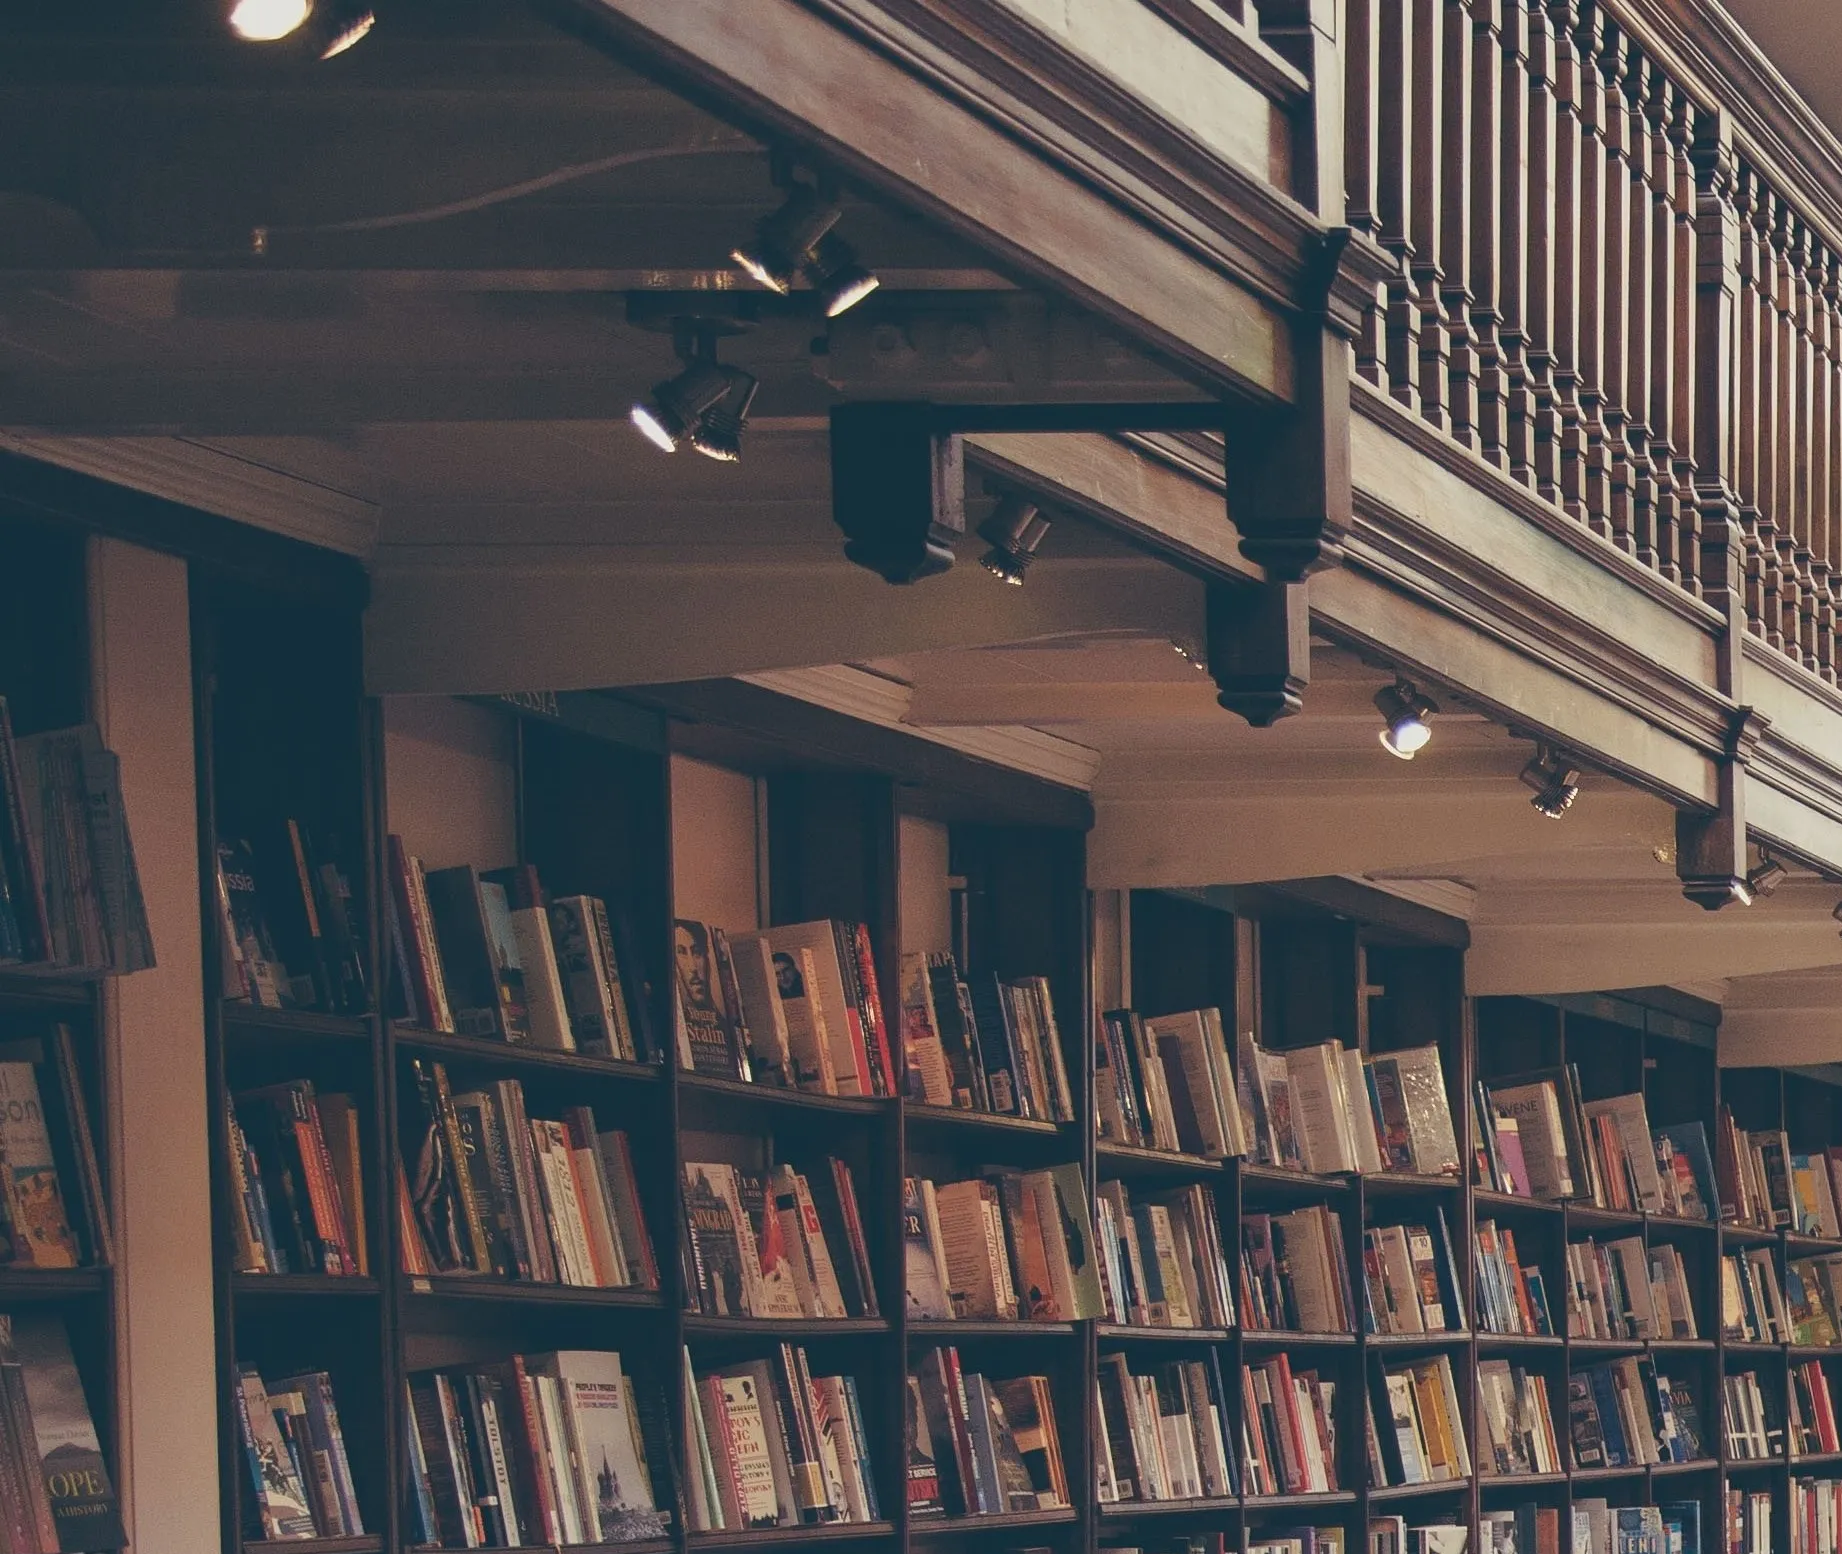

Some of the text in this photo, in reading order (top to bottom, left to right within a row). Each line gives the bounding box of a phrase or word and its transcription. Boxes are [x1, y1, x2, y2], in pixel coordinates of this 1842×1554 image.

[688, 1020, 725, 1044] Stalin
[488, 1418, 506, 1485] TOLSTOY
[66, 1501, 108, 1517] HISTORY
